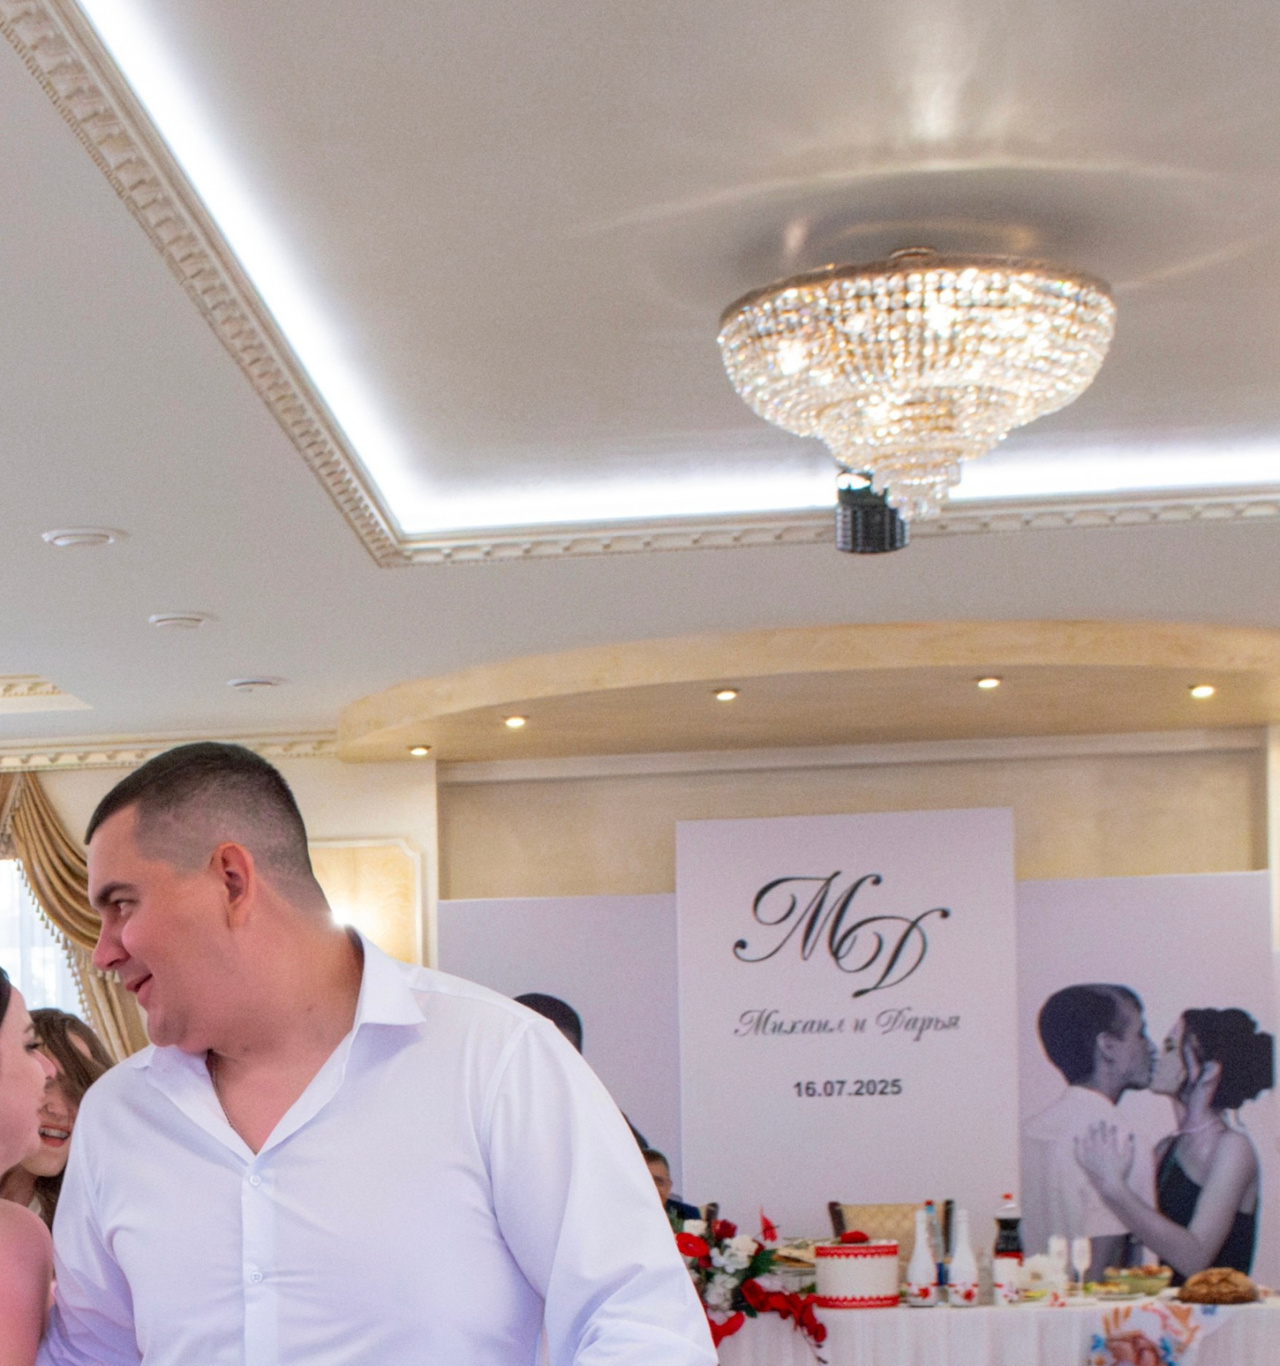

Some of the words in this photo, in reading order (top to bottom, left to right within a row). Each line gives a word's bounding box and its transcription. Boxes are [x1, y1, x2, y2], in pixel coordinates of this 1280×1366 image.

[733, 1008, 845, 1037] Михаил
[853, 1018, 867, 1034] и
[875, 1006, 961, 1042] Дарья
[793, 1079, 903, 1098] 16.07.2025
